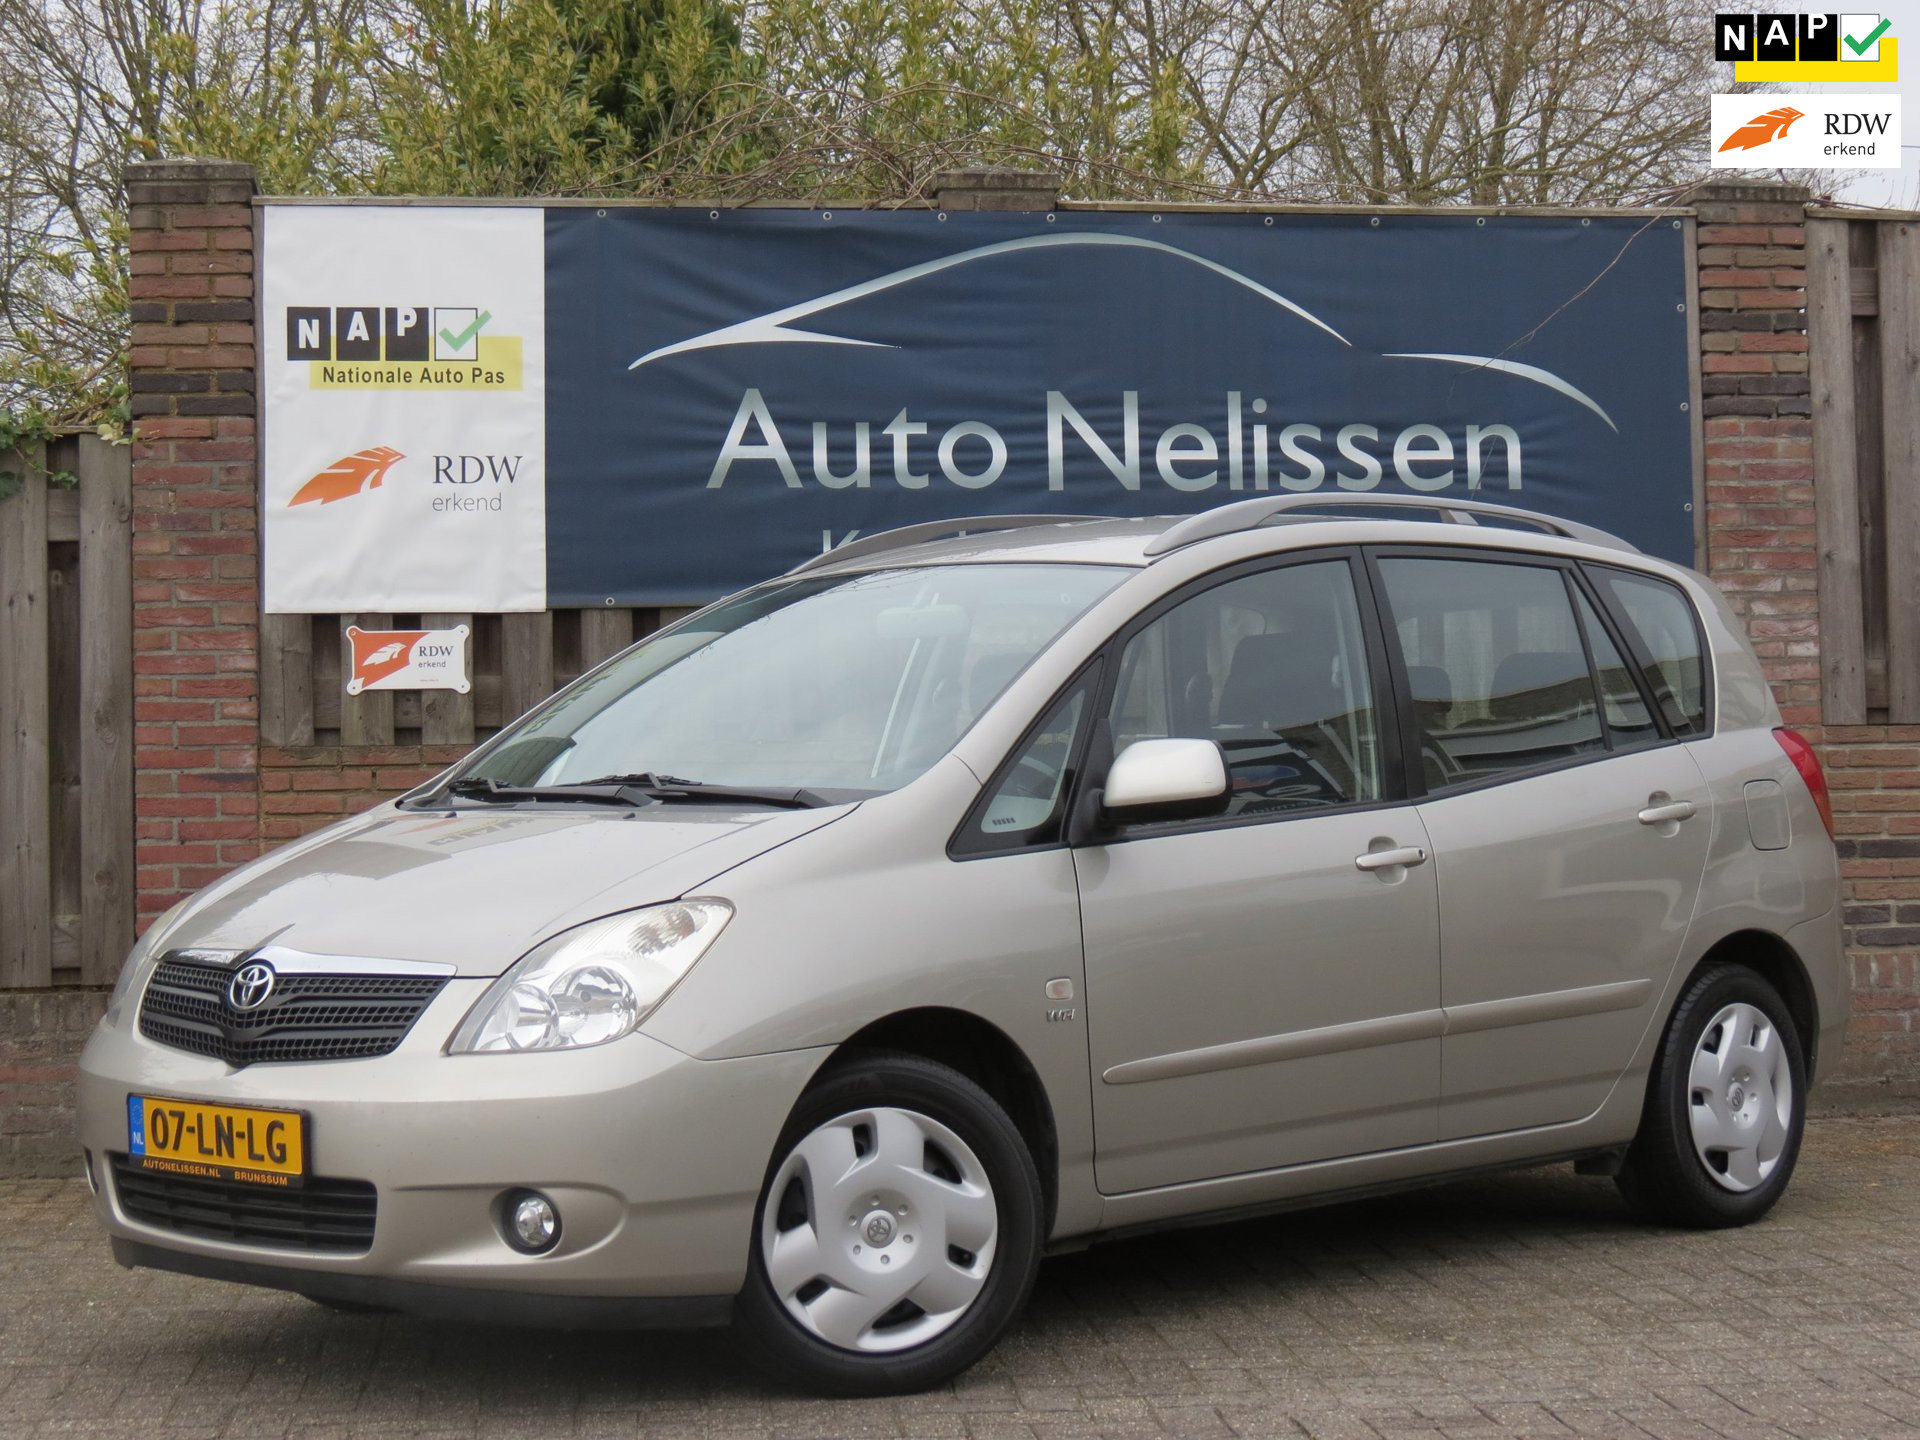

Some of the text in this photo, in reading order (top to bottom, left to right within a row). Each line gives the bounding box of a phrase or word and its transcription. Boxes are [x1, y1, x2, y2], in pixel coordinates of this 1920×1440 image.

[298, 307, 417, 349] NAP
[322, 366, 505, 384] Nationale Auto Pas
[706, 388, 1523, 492] Auto Nelissen
[432, 455, 523, 484] RDW
[432, 491, 502, 512] erkend
[419, 645, 453, 657] RDW
[133, 1131, 144, 1146] NL
[151, 1107, 287, 1165] 07-LN-LG
[143, 1159, 288, 1186] AUTONELISSEN.NL BRUNSSUM
